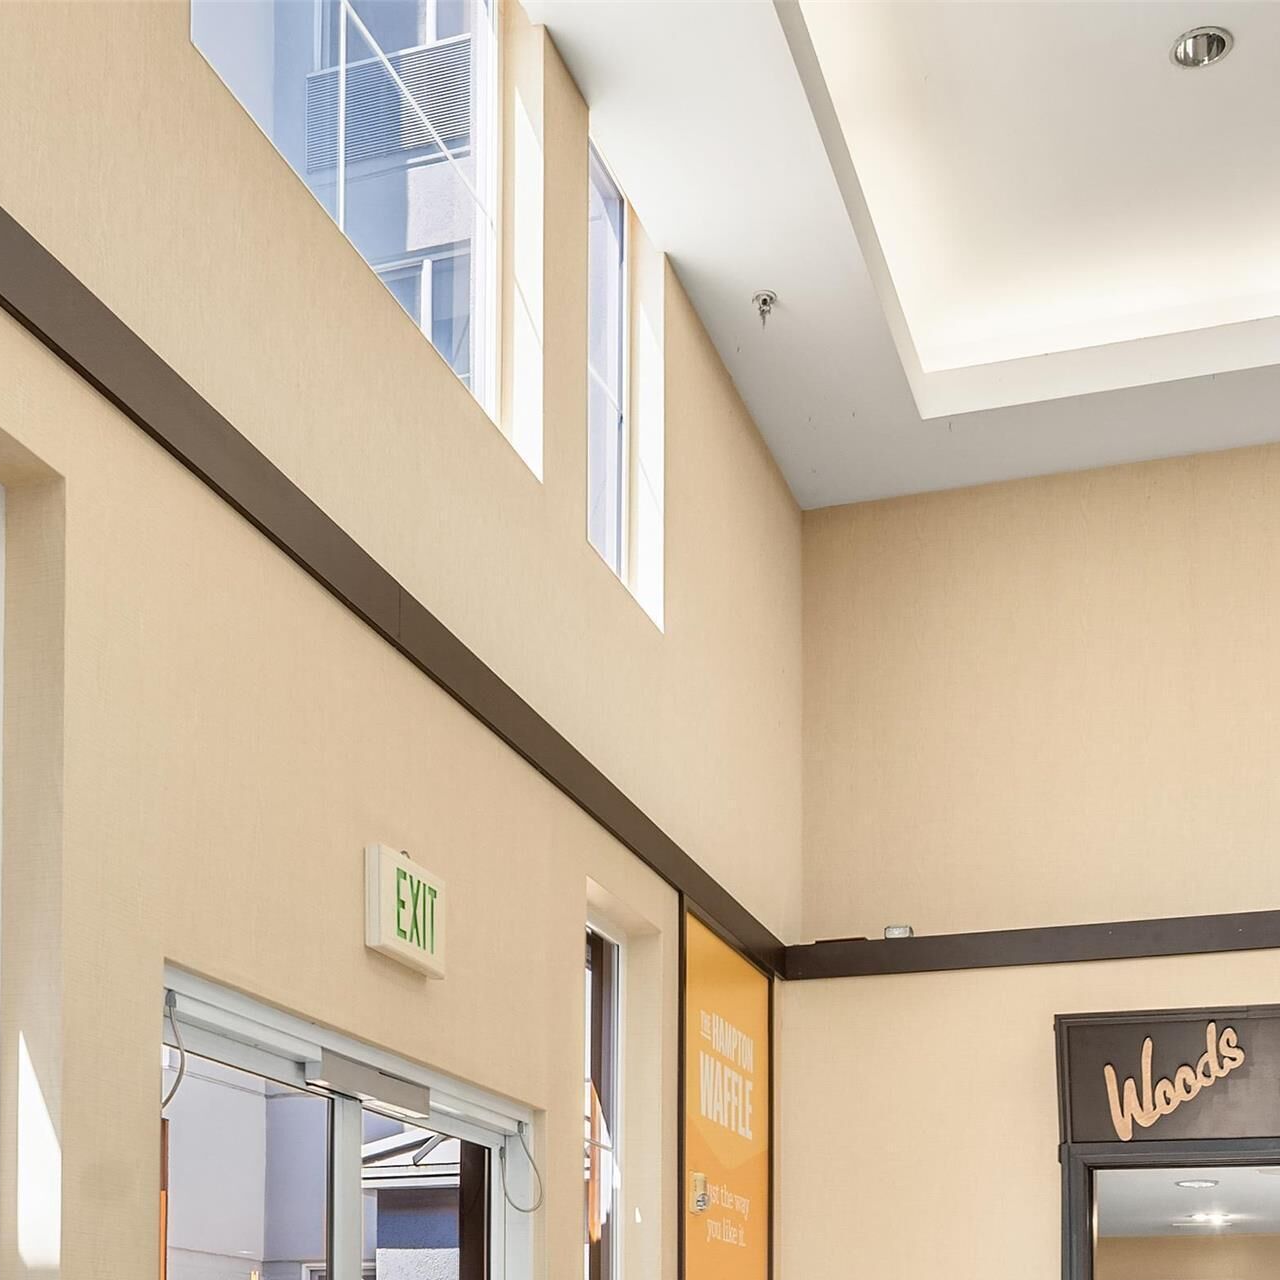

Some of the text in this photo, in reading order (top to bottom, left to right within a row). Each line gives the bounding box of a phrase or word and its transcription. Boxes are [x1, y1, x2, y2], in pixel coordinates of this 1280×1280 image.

[397, 867, 437, 955] EXIT
[712, 1012, 753, 1074] HAMPTON
[1104, 1020, 1245, 1141] Woods
[699, 1049, 753, 1141] WAFFLE
